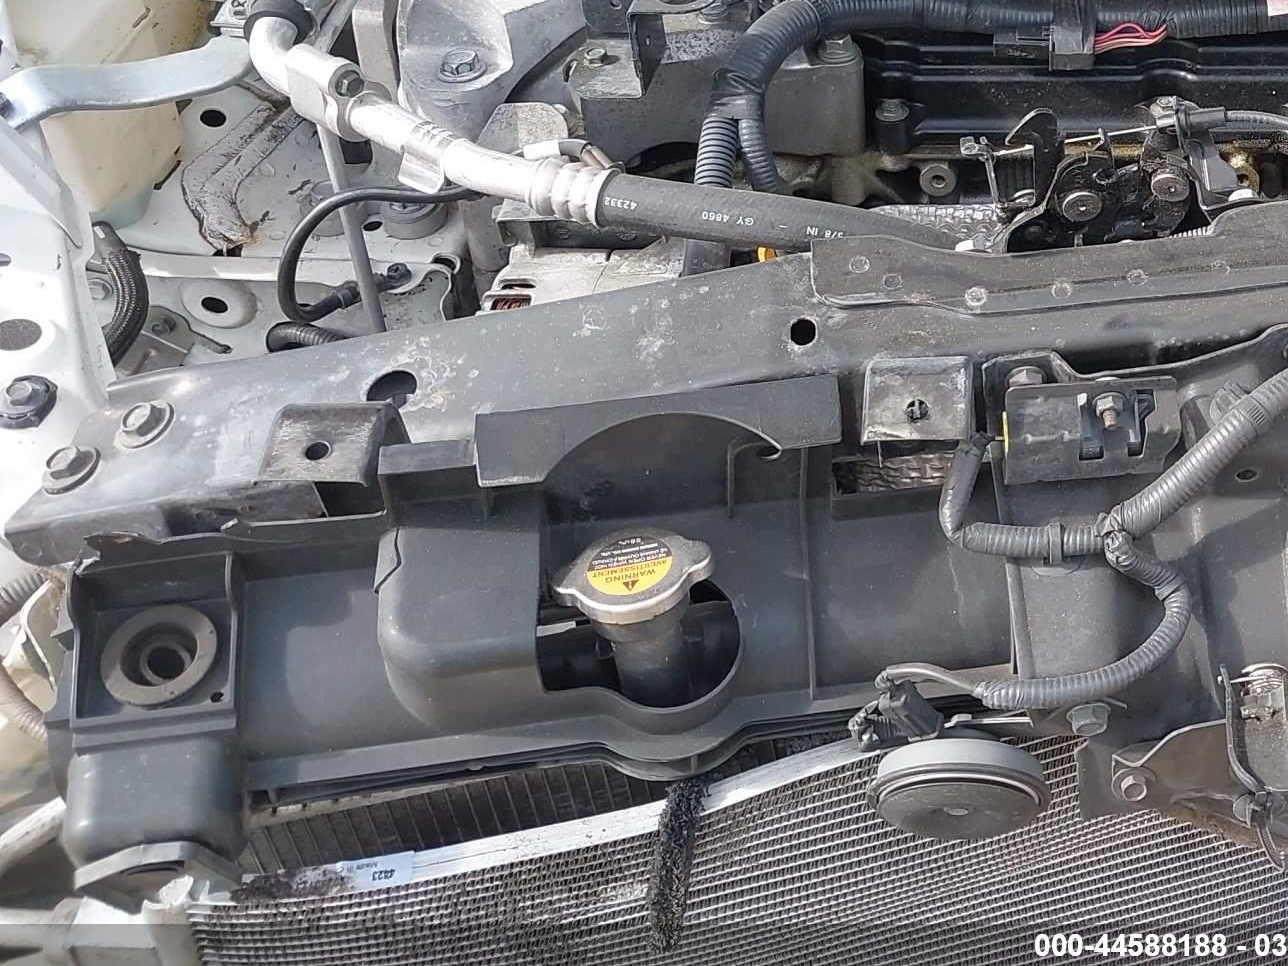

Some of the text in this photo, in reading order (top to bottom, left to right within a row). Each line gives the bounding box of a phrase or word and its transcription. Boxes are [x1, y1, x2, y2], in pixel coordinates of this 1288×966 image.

[604, 195, 638, 210] 42332
[702, 211, 730, 223] 4860
[737, 215, 754, 226] GY
[806, 226, 819, 236] IN
[591, 559, 668, 578] AVERTISSEMENT
[605, 568, 656, 583] WARNING
